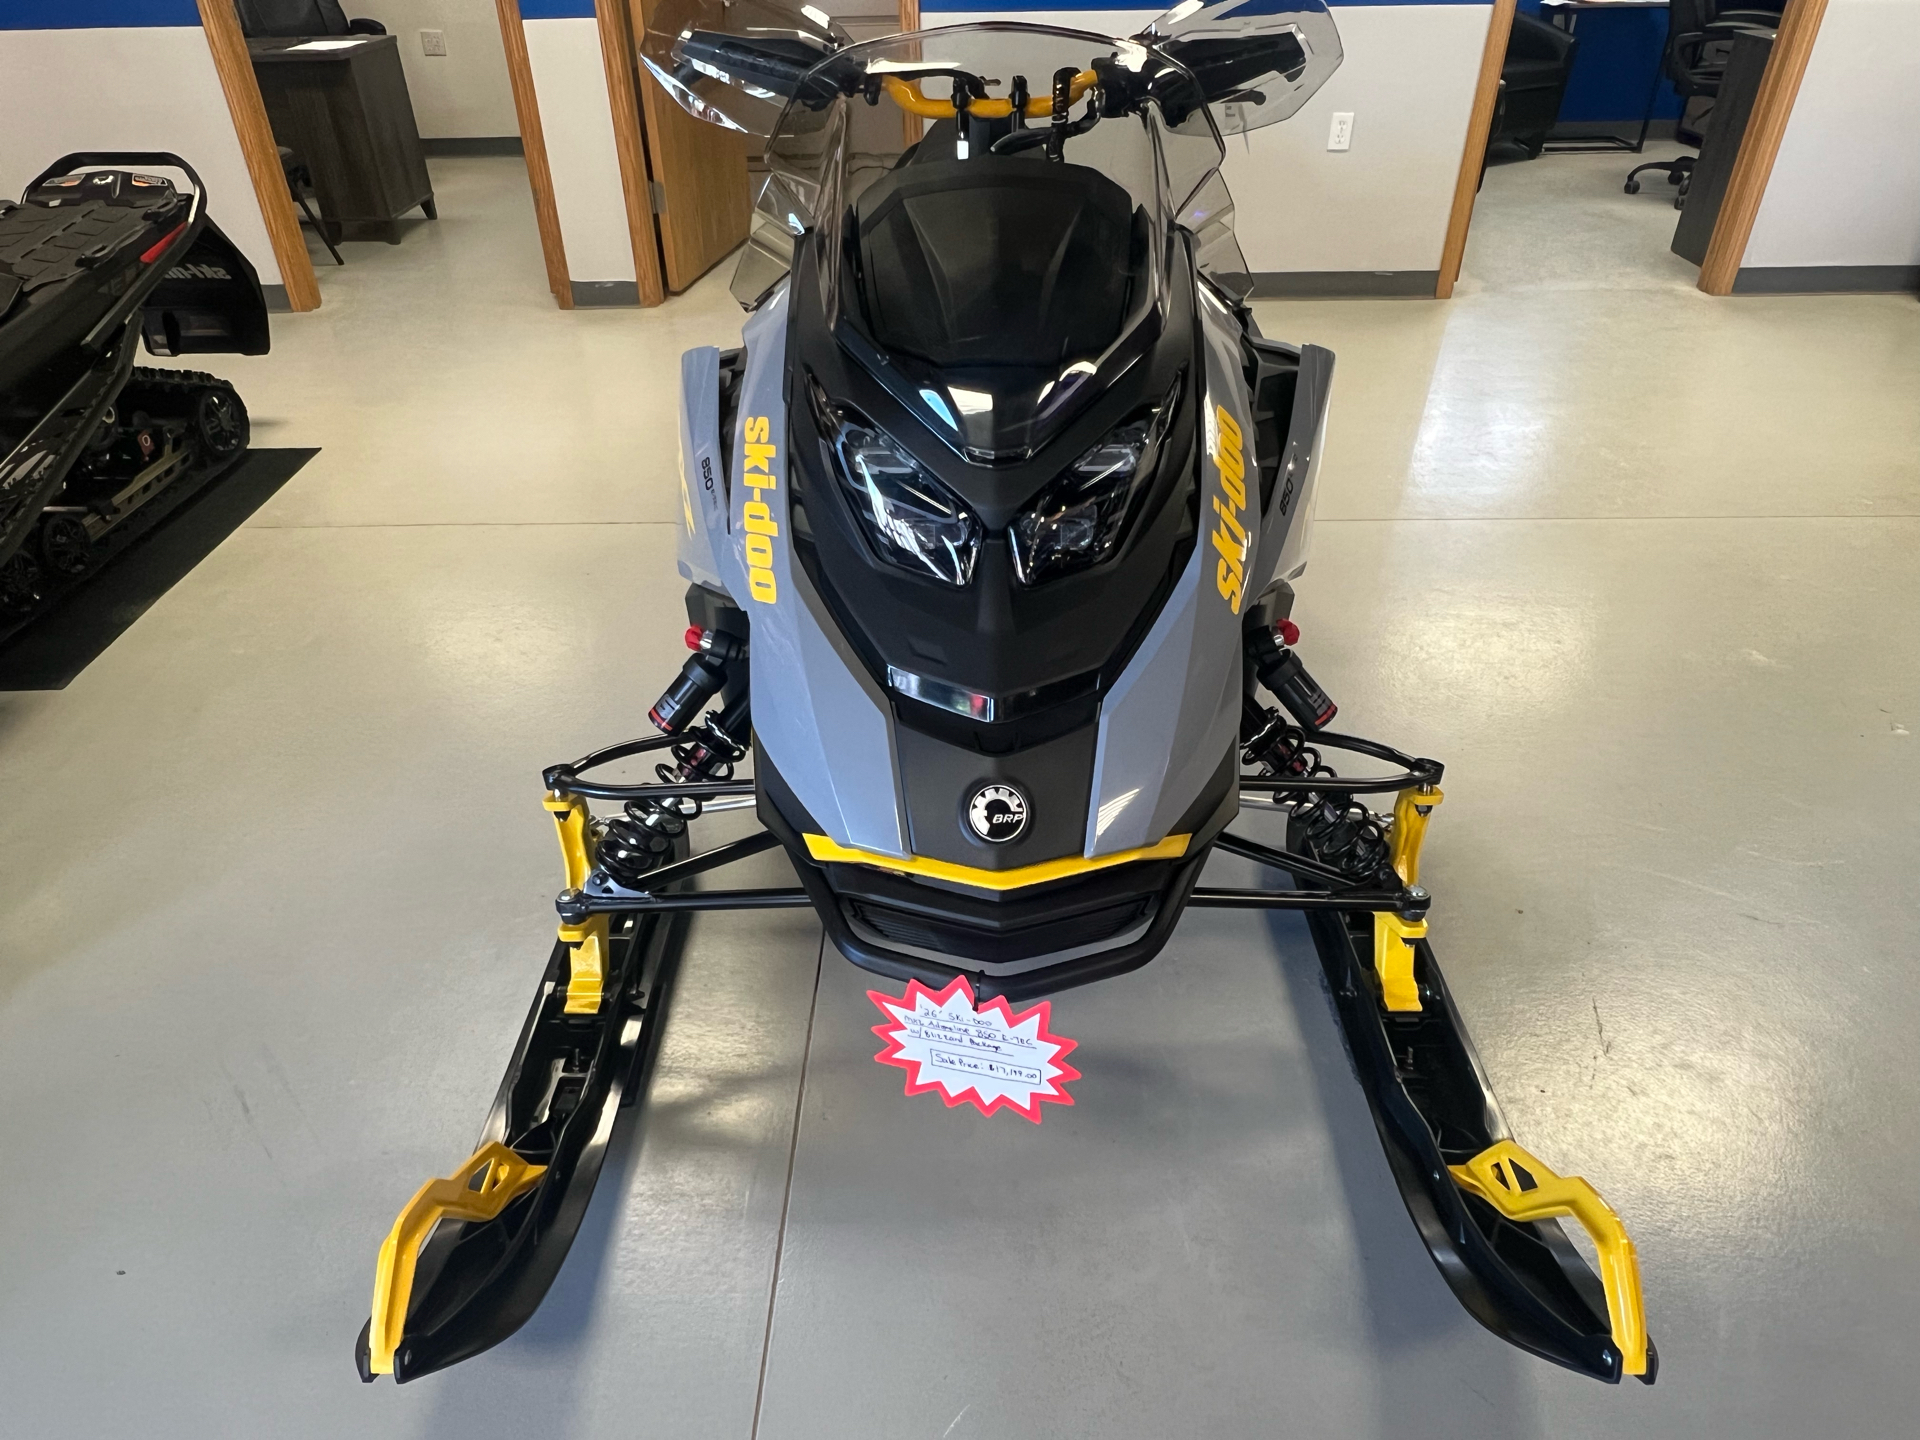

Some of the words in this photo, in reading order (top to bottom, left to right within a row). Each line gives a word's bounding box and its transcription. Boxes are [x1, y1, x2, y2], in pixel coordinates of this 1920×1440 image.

[701, 456, 714, 491] 850
[743, 415, 778, 605] ski-doo
[1211, 404, 1249, 615] ski-doo
[1279, 478, 1294, 517] 850
[992, 813, 1024, 824] BRP
[975, 1028, 997, 1040] 850
[935, 1053, 956, 1066] Sale
